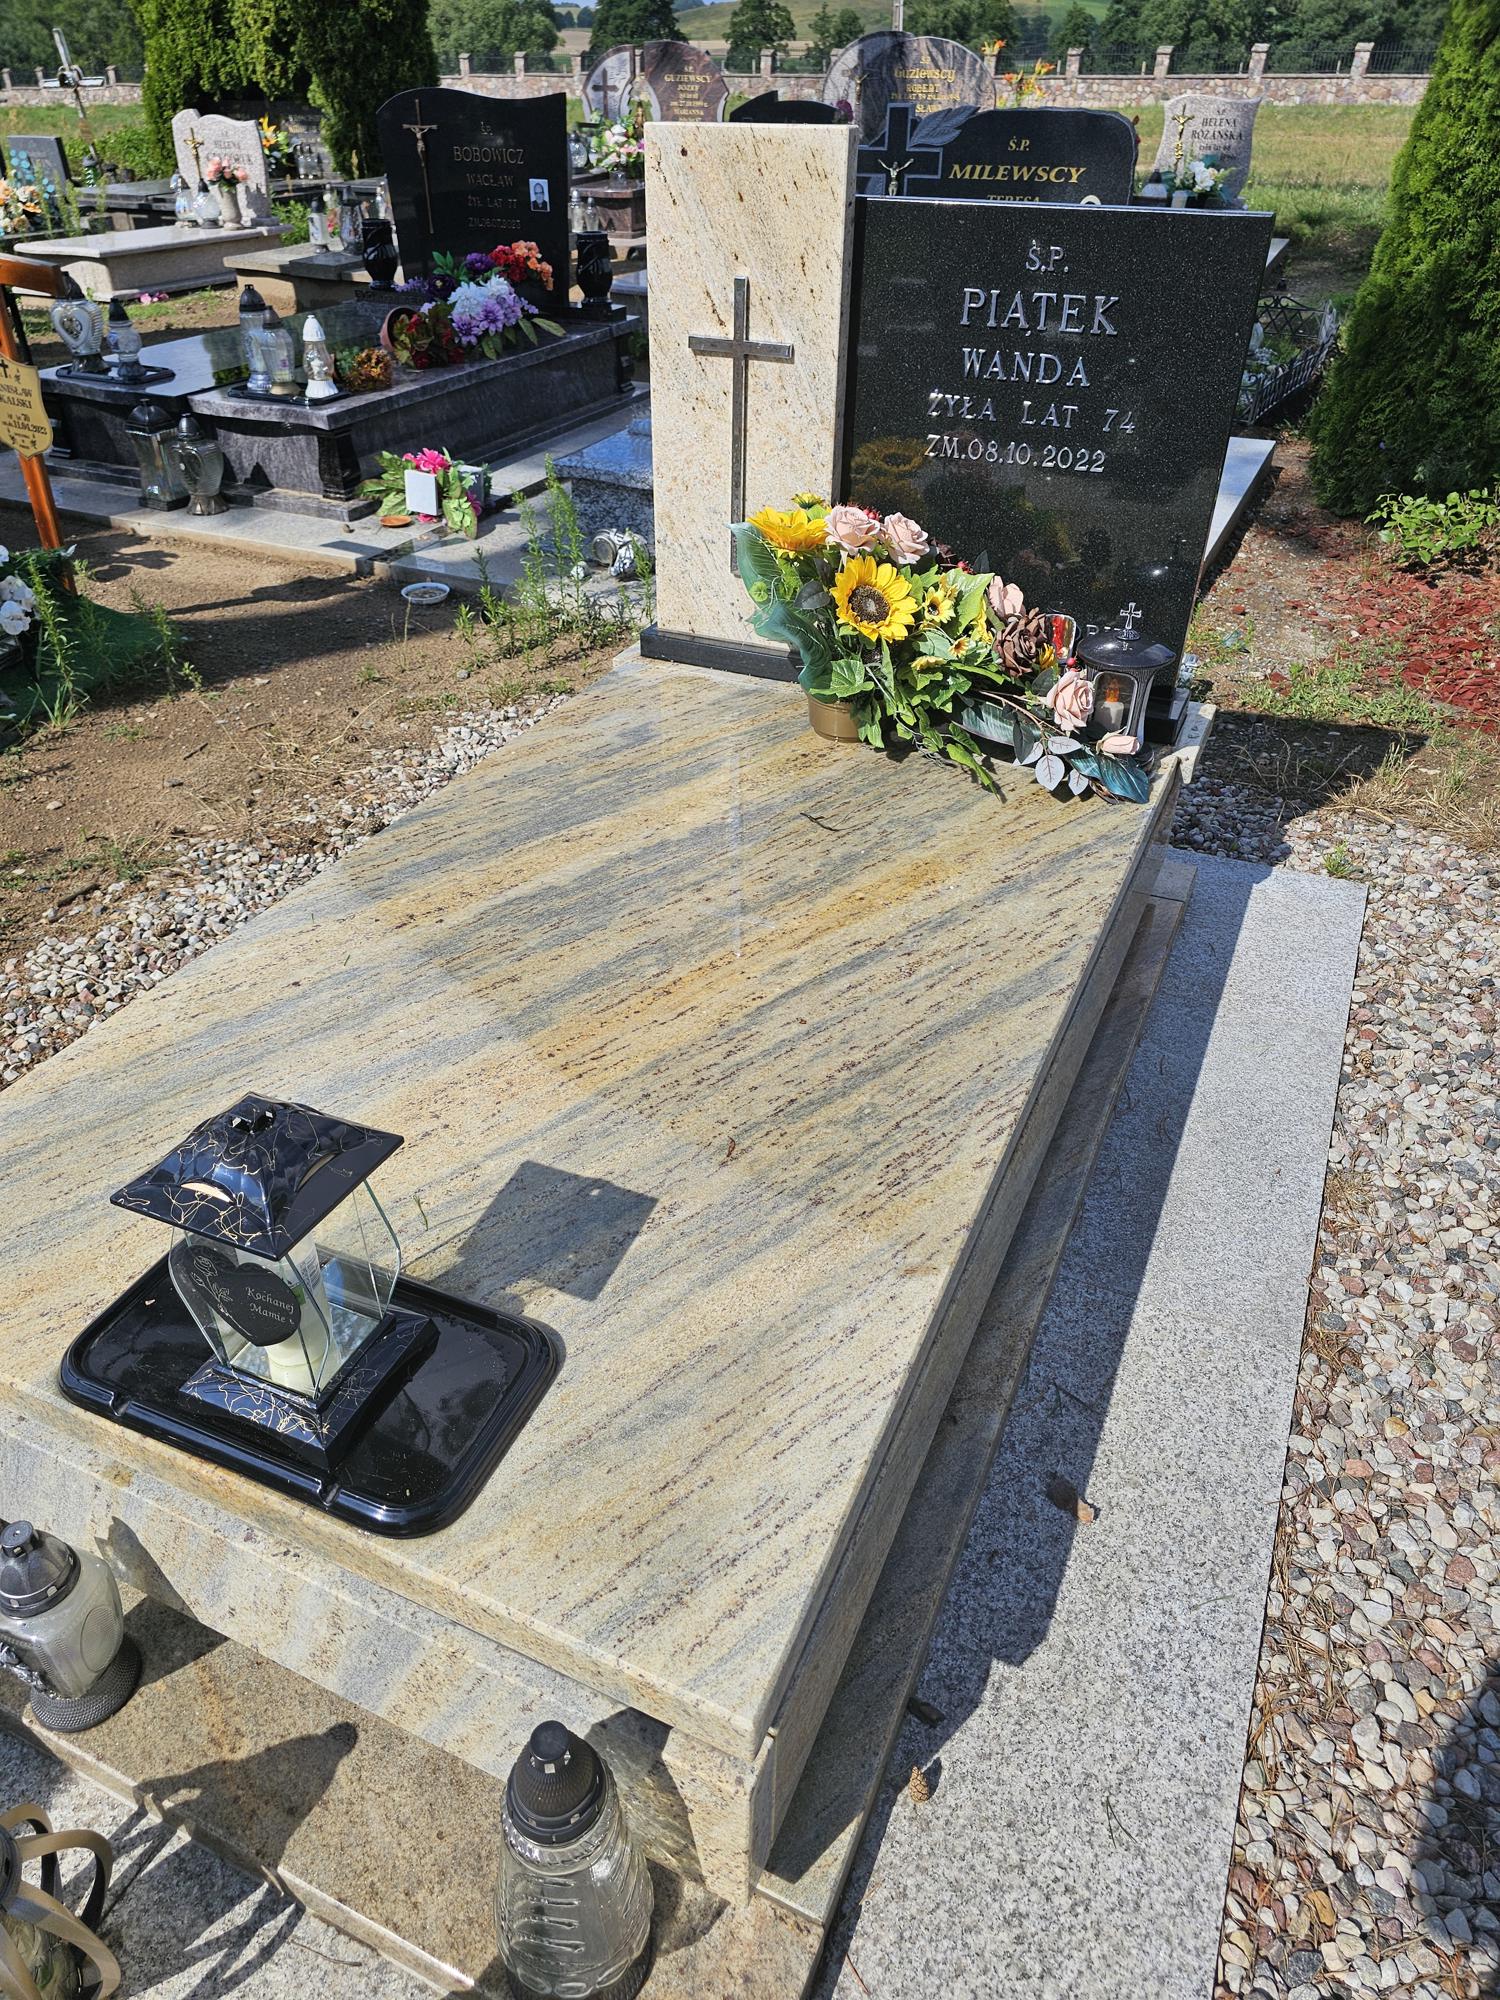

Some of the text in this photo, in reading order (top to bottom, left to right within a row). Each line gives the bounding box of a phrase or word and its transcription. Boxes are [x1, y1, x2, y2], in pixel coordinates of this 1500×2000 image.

[664, 73, 712, 83] GUZIEWSCY
[1202, 117, 1237, 128] HELENA
[1007, 135, 1030, 151] Ś.P.
[453, 146, 525, 165] BOBOWICZ
[466, 173, 514, 188] WACŁAW
[948, 163, 1087, 184] MILEWSCY
[1025, 239, 1069, 273] Ś.P.
[959, 287, 1120, 337] PIĄTEK
[962, 347, 1091, 387] WANDA
[926, 388, 1137, 434] ŻYŁA LAT 74
[924, 433, 1106, 473] ZM.08.10.2022
[245, 1286, 294, 1315] Kochanej
[249, 1302, 286, 1323] Mamie
